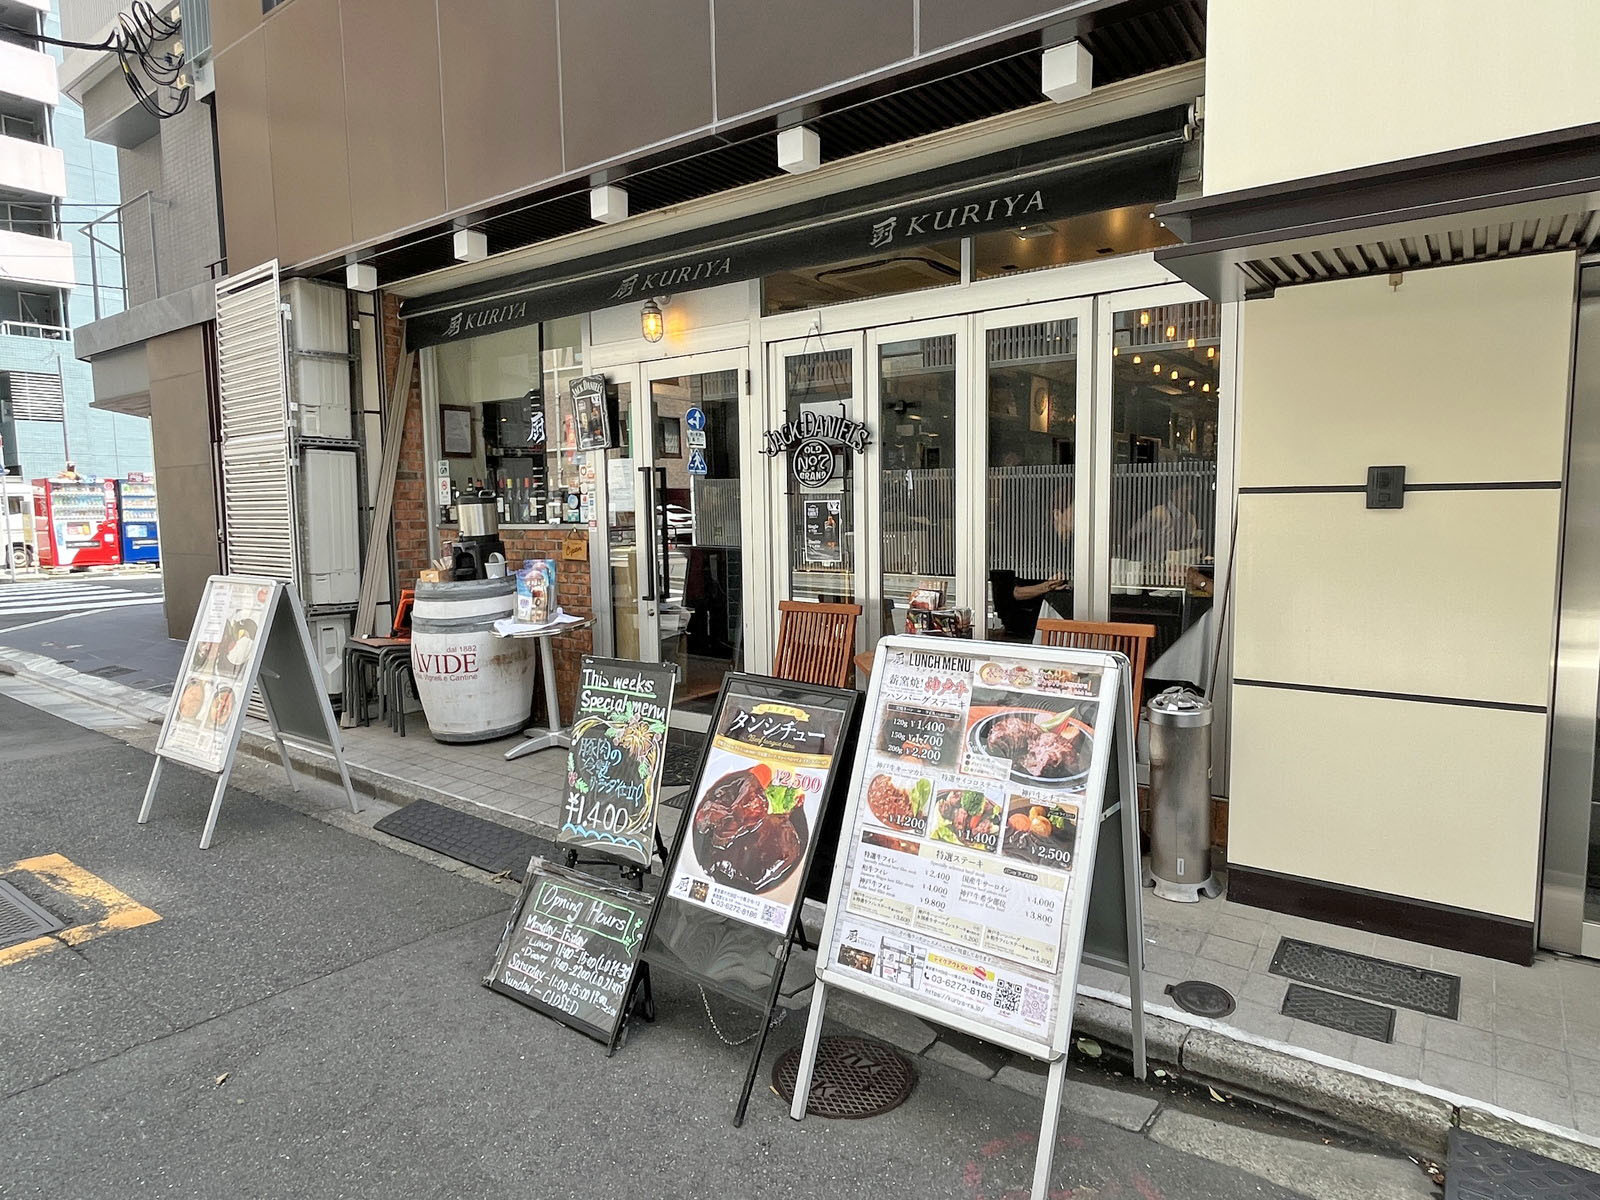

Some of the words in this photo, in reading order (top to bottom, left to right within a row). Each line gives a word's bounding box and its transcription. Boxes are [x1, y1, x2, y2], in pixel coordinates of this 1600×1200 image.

[905, 190, 1044, 236] KURIYA
[641, 257, 731, 291] KURIYA
[464, 302, 526, 329] KURIYA
[764, 419, 801, 457] JACK
[802, 411, 870, 454] DANIEL'S
[804, 445, 822, 454] OLD
[800, 470, 827, 481] BRAND
[908, 653, 941, 668] LUNCH
[941, 656, 971, 672] MENU
[583, 668, 609, 686] This
[613, 673, 655, 693] weeks
[581, 690, 626, 712] Special
[632, 701, 666, 721] menu
[886, 691, 966, 709] ハンバーグステーキ
[730, 710, 826, 742] タンシチュー
[893, 718, 908, 728] 120g
[891, 731, 906, 741] 150g
[888, 744, 903, 755] 200g
[936, 850, 984, 868] 特選ステーキ
[587, 899, 626, 931] Hours
[931, 974, 993, 1000] 03-6272-8186
